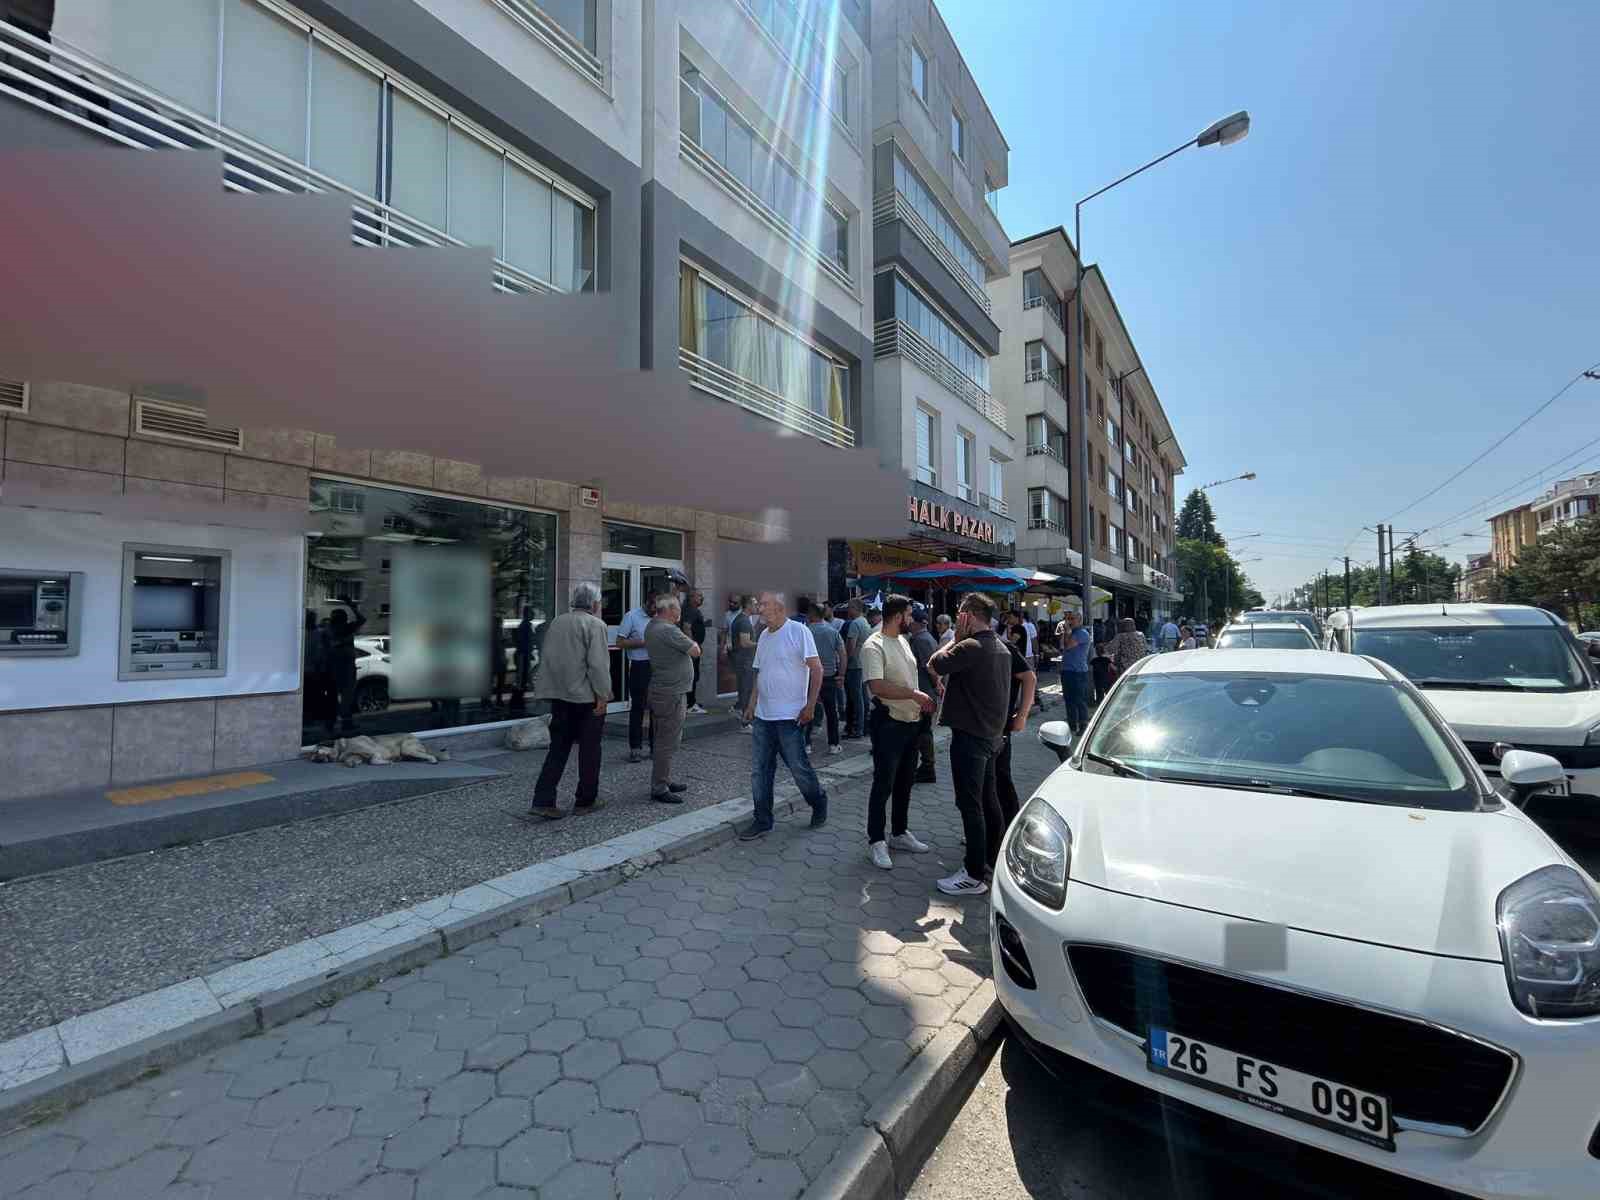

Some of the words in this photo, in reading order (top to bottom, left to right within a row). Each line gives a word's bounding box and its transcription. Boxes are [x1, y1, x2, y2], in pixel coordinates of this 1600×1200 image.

[908, 496, 950, 532] HALK
[953, 511, 997, 545] PAZARI
[1152, 1047, 1167, 1060] TR
[1170, 1037, 1207, 1075] 26
[1236, 1056, 1279, 1098] FS
[1311, 1081, 1383, 1132] 099
